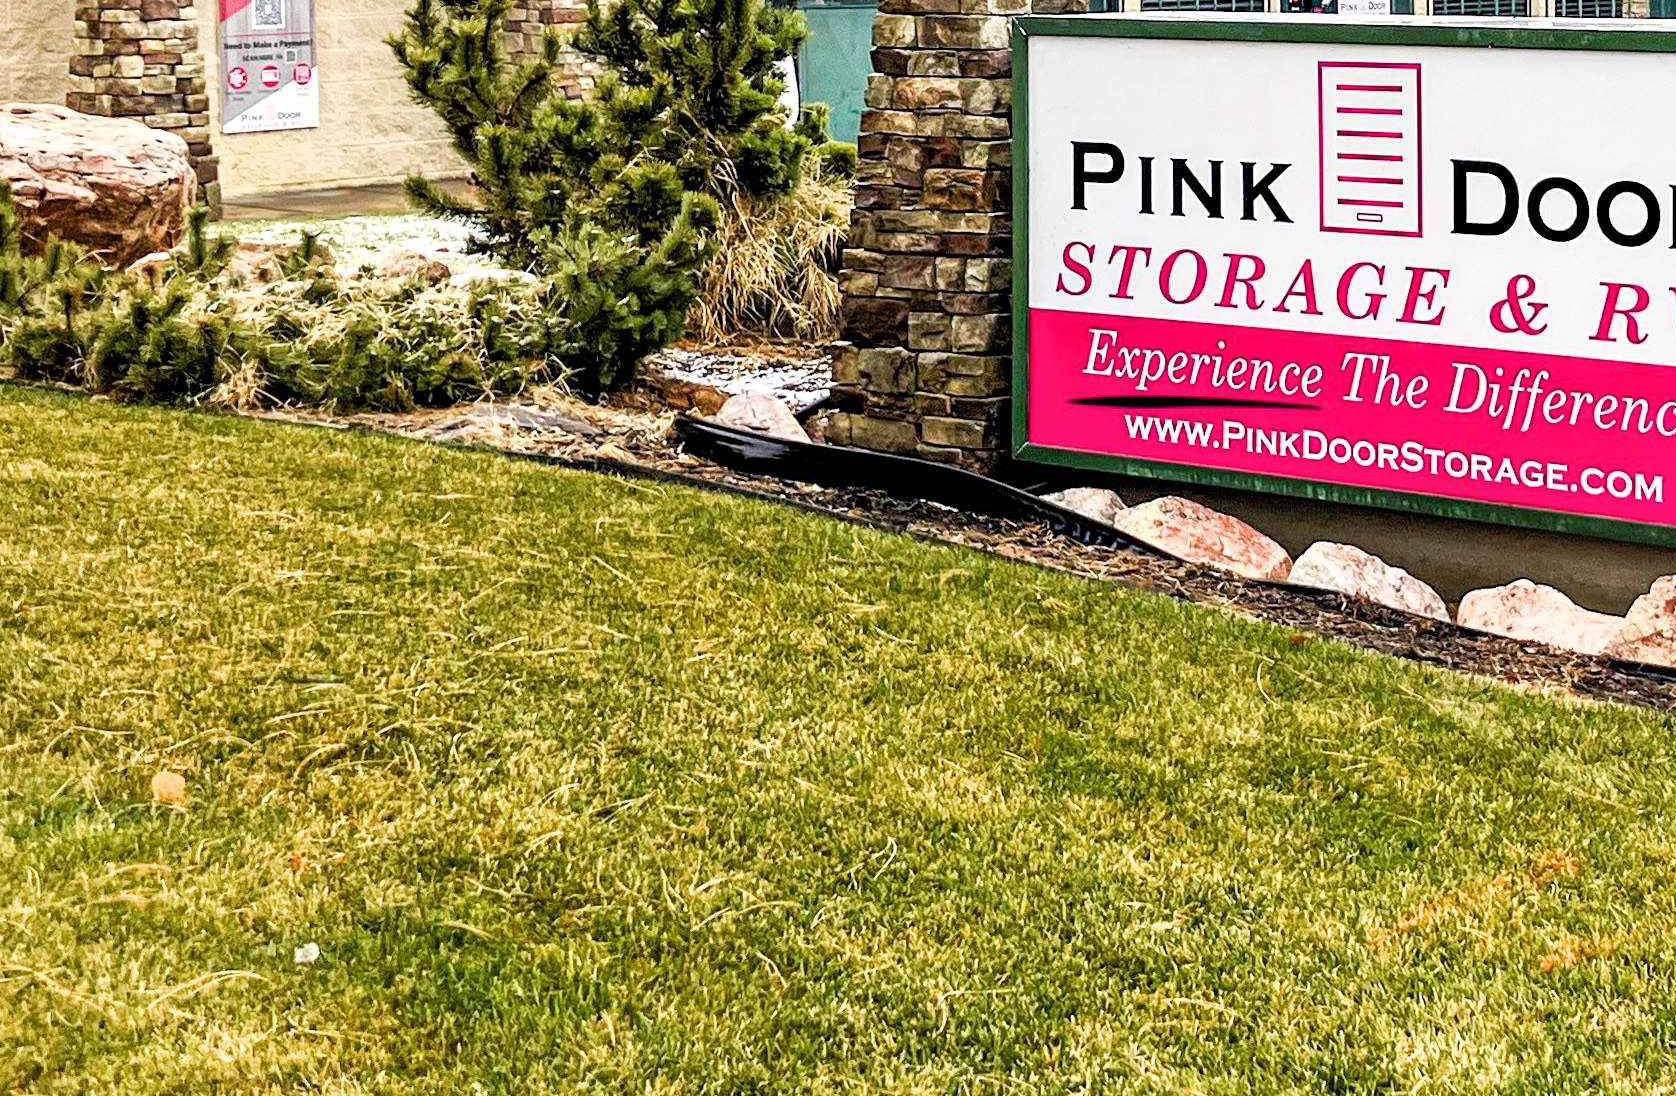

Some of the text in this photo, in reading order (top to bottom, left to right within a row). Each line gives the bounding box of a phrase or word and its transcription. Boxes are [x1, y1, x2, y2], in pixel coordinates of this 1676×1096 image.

[1070, 141, 1294, 224] PINK
[1056, 241, 1450, 325] STORAGE
[1489, 274, 1549, 335] &
[1082, 328, 1323, 398] Experience
[1340, 352, 1430, 409] The
